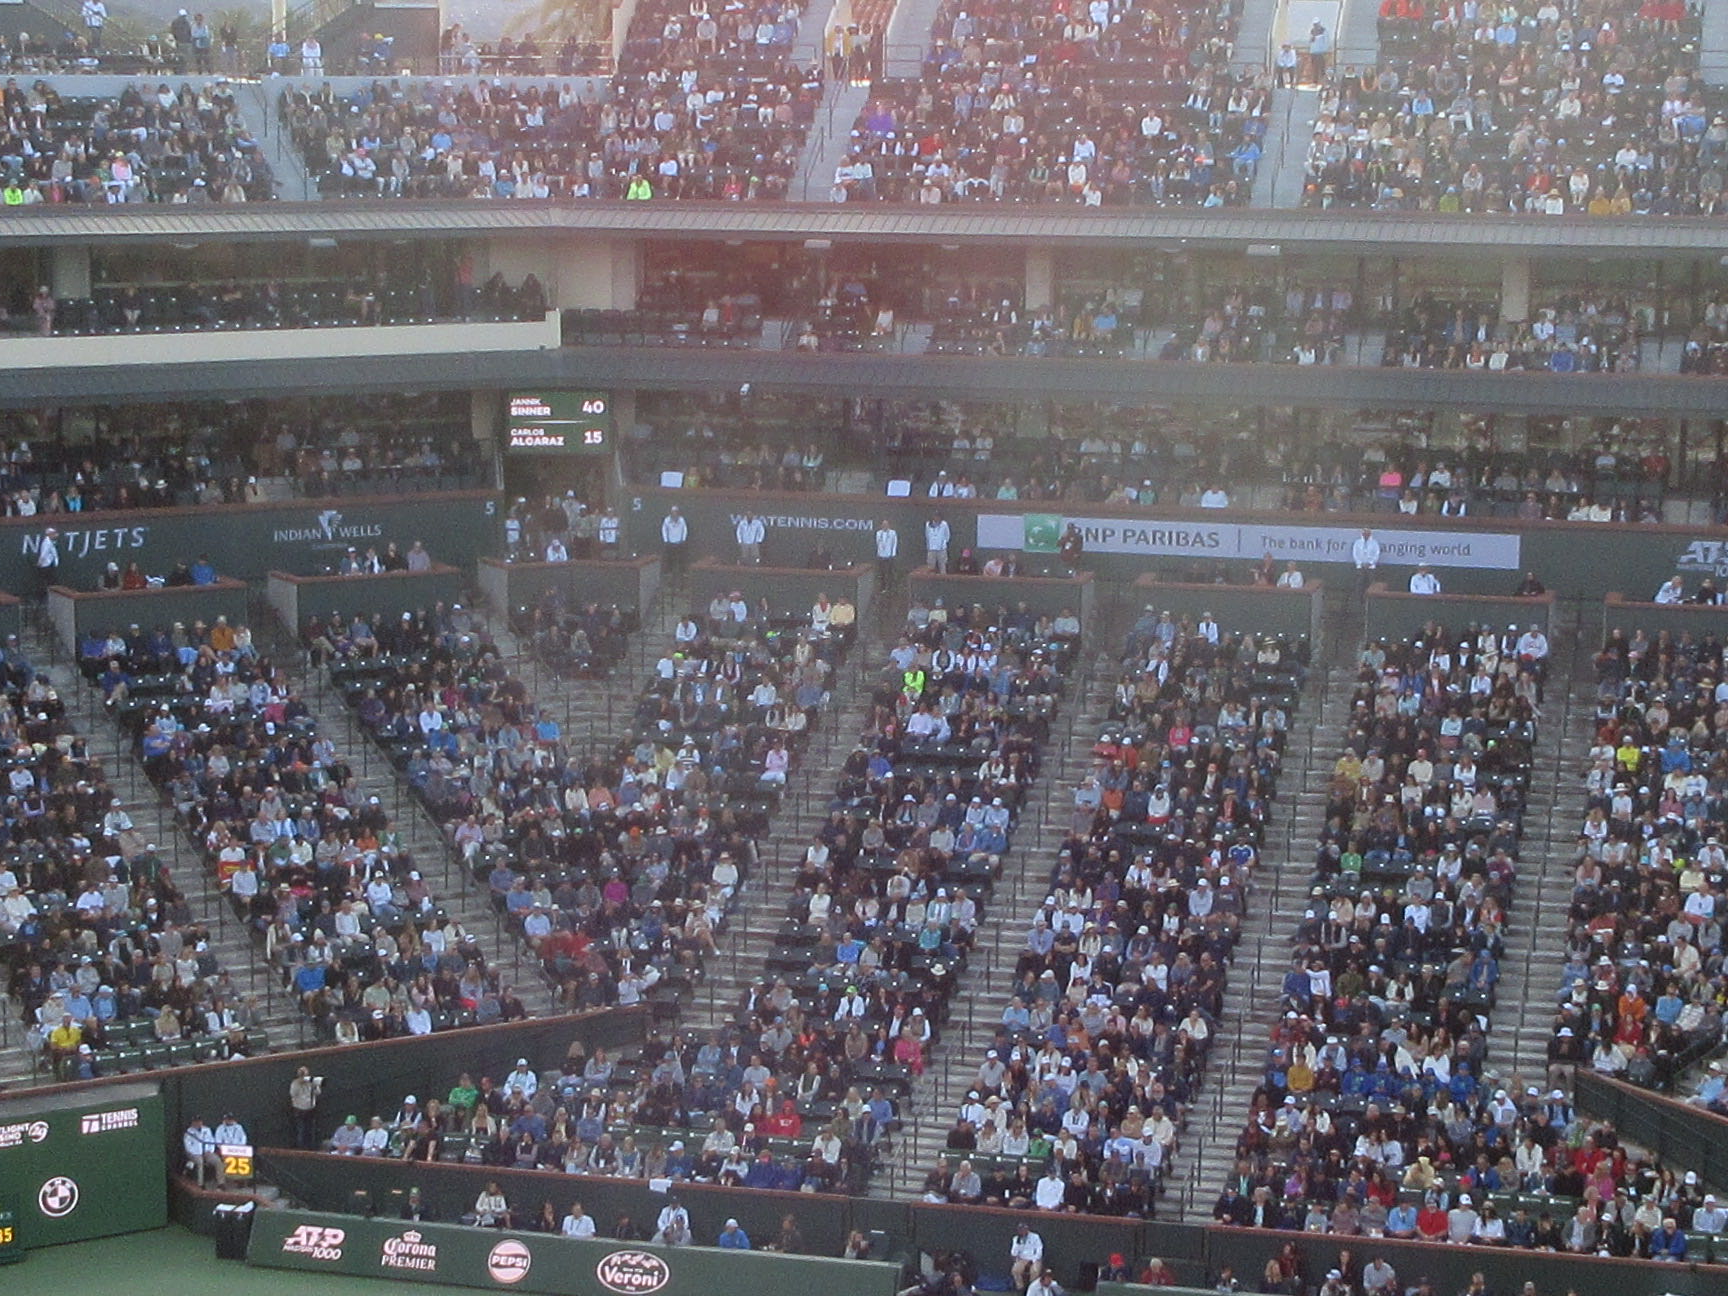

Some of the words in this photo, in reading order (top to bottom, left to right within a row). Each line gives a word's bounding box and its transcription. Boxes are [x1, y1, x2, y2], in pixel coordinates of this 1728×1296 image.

[510, 406, 552, 416] SINNER
[582, 400, 604, 414] 40
[510, 428, 545, 436] CARLOS
[510, 436, 565, 446] ALCARAZ
[584, 430, 602, 444] 15
[485, 501, 495, 515] 5
[633, 498, 642, 511] 5
[274, 528, 322, 542] INDIAN
[339, 525, 383, 538] WELLS
[1123, 528, 1220, 548] PARIBAS
[21, 527, 146, 559] NTJETS
[1260, 535, 1285, 549] The
[1290, 535, 1322, 551] bank
[1326, 538, 1346, 554] for
[1430, 544, 1471, 557] world
[101, 1108, 139, 1124] TENNIS
[225, 1157, 251, 1175] 25
[283, 1224, 346, 1248] ATP
[312, 1247, 343, 1261] 1000
[383, 1237, 437, 1257] Corona
[381, 1254, 436, 1271] PREMIER
[492, 1254, 527, 1268] PEPSI
[603, 1265, 660, 1286] Veroni
